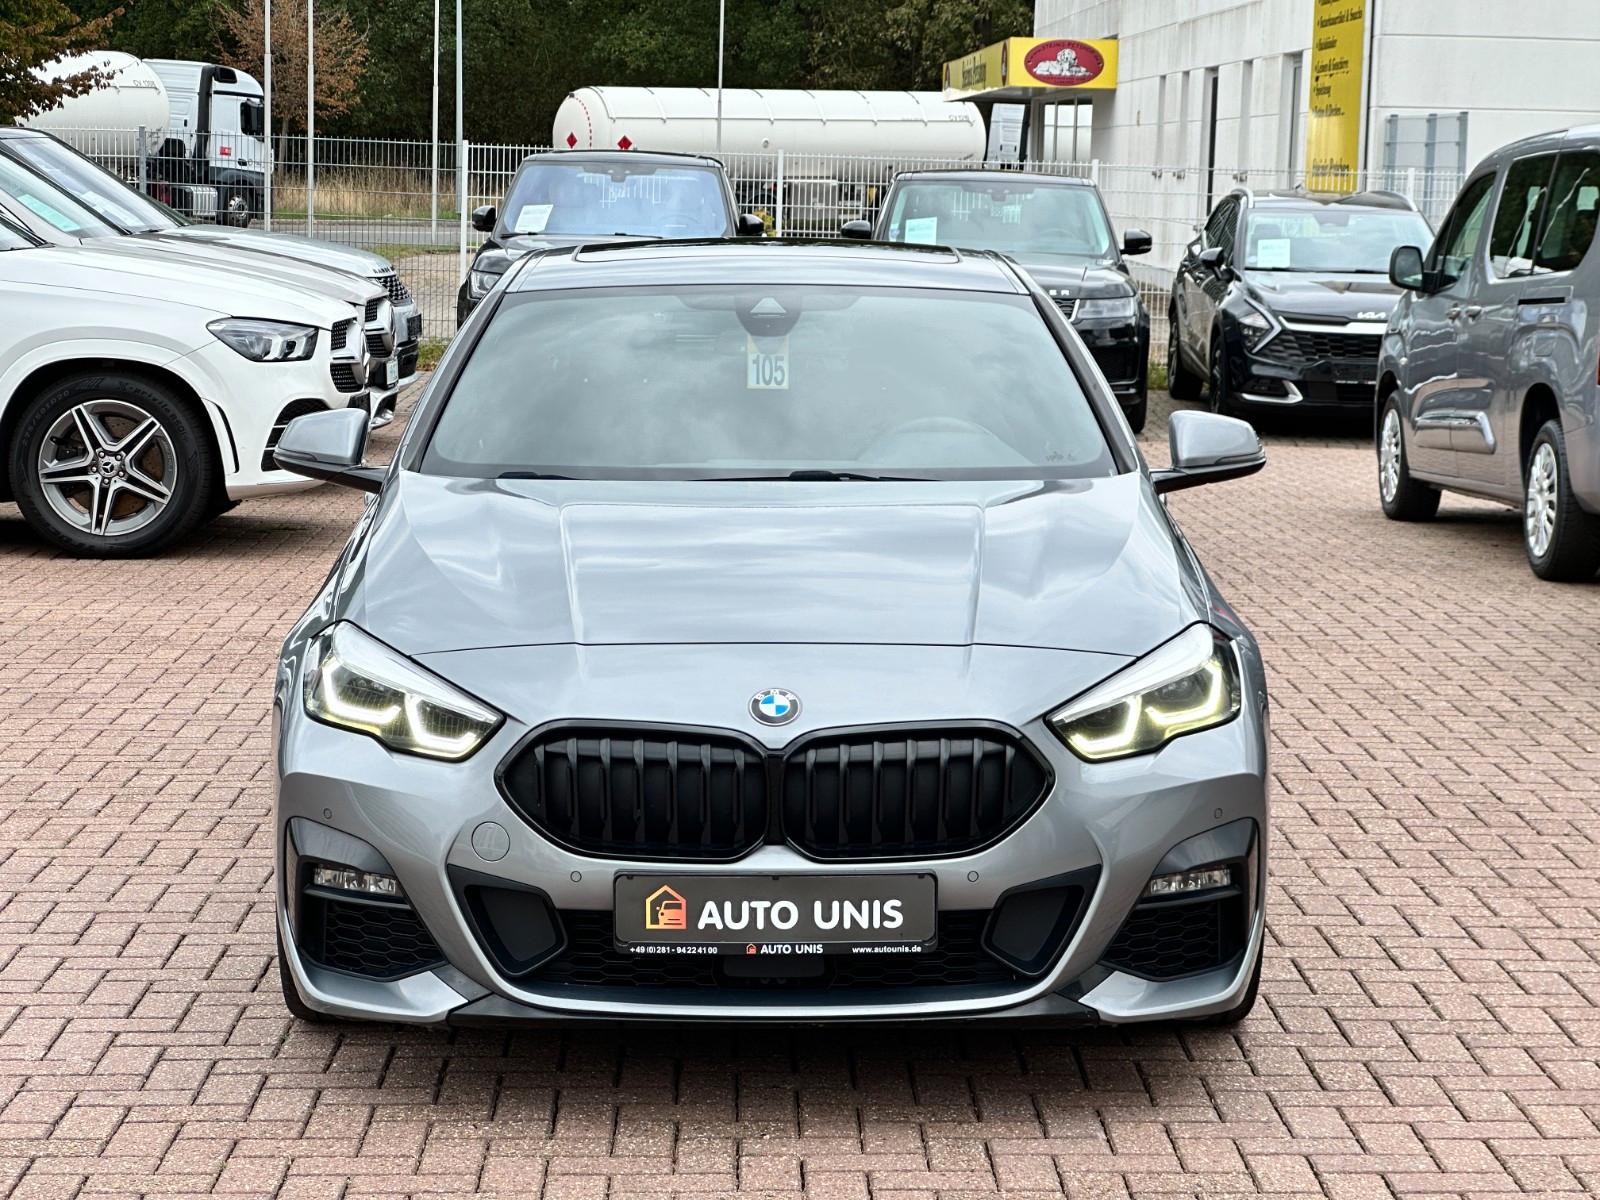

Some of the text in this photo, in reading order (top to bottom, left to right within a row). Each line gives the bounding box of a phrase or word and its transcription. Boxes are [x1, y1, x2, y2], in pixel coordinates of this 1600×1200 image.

[752, 354, 786, 386] 105
[754, 688, 797, 702] BMW
[698, 899, 904, 931] AUTO UNIS
[629, 945, 646, 954] +49
[760, 943, 824, 955] AUTO UNIS
[852, 944, 922, 954] www.autounis.de
